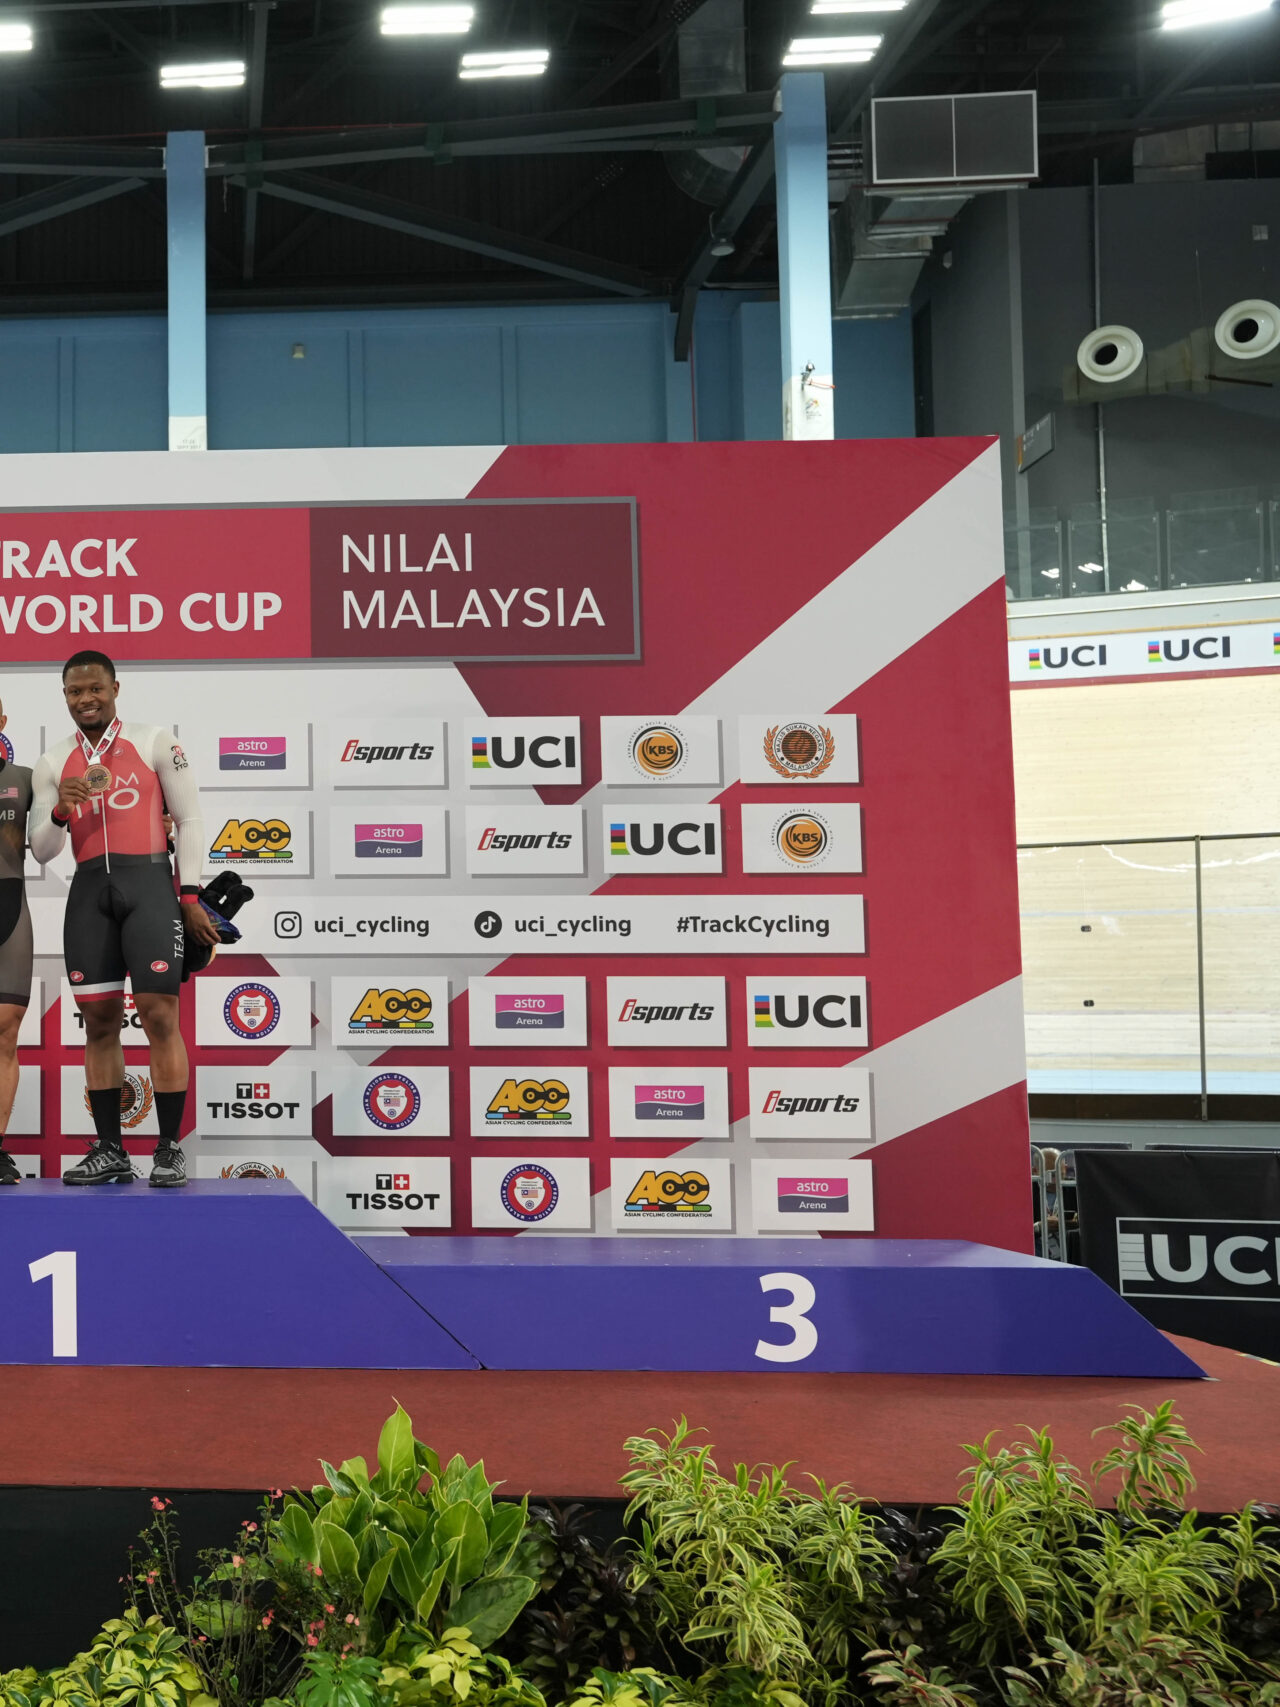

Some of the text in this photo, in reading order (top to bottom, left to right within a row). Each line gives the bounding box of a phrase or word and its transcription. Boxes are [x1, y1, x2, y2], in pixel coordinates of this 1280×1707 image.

[343, 533, 472, 573] NILAI
[179, 592, 282, 632] CUP
[343, 588, 605, 628] MALAYSIA
[1043, 645, 1107, 669] UCI
[1164, 635, 1230, 661] UCI
[237, 740, 268, 751] astro
[491, 736, 576, 768] UCI
[648, 745, 674, 756] KBS
[239, 759, 266, 767] Arena
[373, 827, 405, 838] astro
[630, 822, 716, 855] UCI
[793, 833, 819, 845] KBS
[375, 846, 402, 854] Arena
[314, 915, 430, 938] uci_cycling
[514, 915, 632, 937] uci_cycling
[676, 915, 830, 938] #TrackCycling
[172, 919, 184, 958] TEAM
[513, 998, 546, 1009] astro
[775, 995, 861, 1028] UCI
[515, 1017, 543, 1025] Arena
[653, 1088, 686, 1100] astro
[207, 1102, 300, 1119] TISSOT
[655, 1108, 683, 1117] Arena
[796, 1181, 829, 1192] astro
[346, 1193, 440, 1210] TISSOT
[798, 1201, 827, 1209] Arena
[28, 1251, 78, 1358] 1
[754, 1273, 818, 1363] 3
